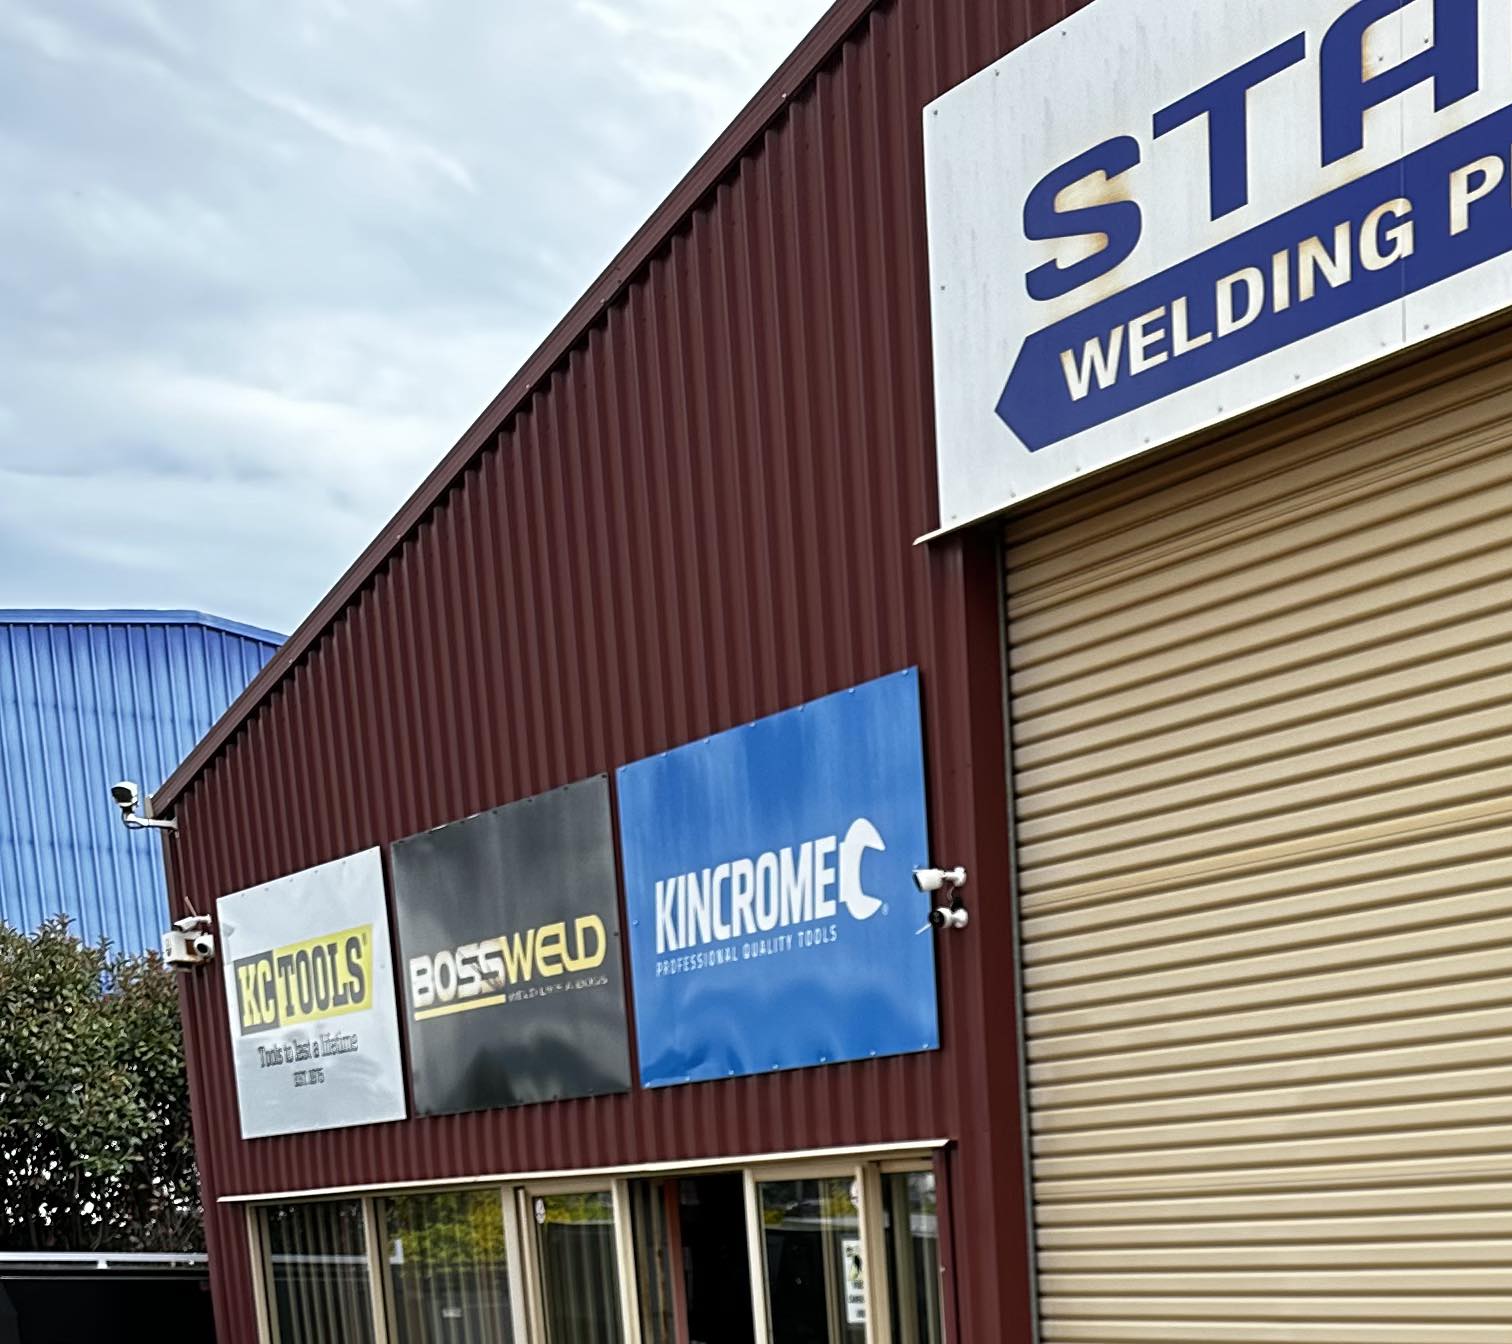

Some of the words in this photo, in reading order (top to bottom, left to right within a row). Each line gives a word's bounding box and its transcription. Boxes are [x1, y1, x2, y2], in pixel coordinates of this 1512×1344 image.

[1058, 197, 1416, 403] WELDING
[655, 835, 838, 955] KINCROME
[238, 959, 276, 1028] KC
[277, 936, 366, 1018] TOOLS
[409, 914, 607, 1009] BOSSWELD
[655, 946, 739, 978] PROFESSIONAL
[743, 934, 793, 961] QUALITY
[797, 924, 838, 949] TOOLS
